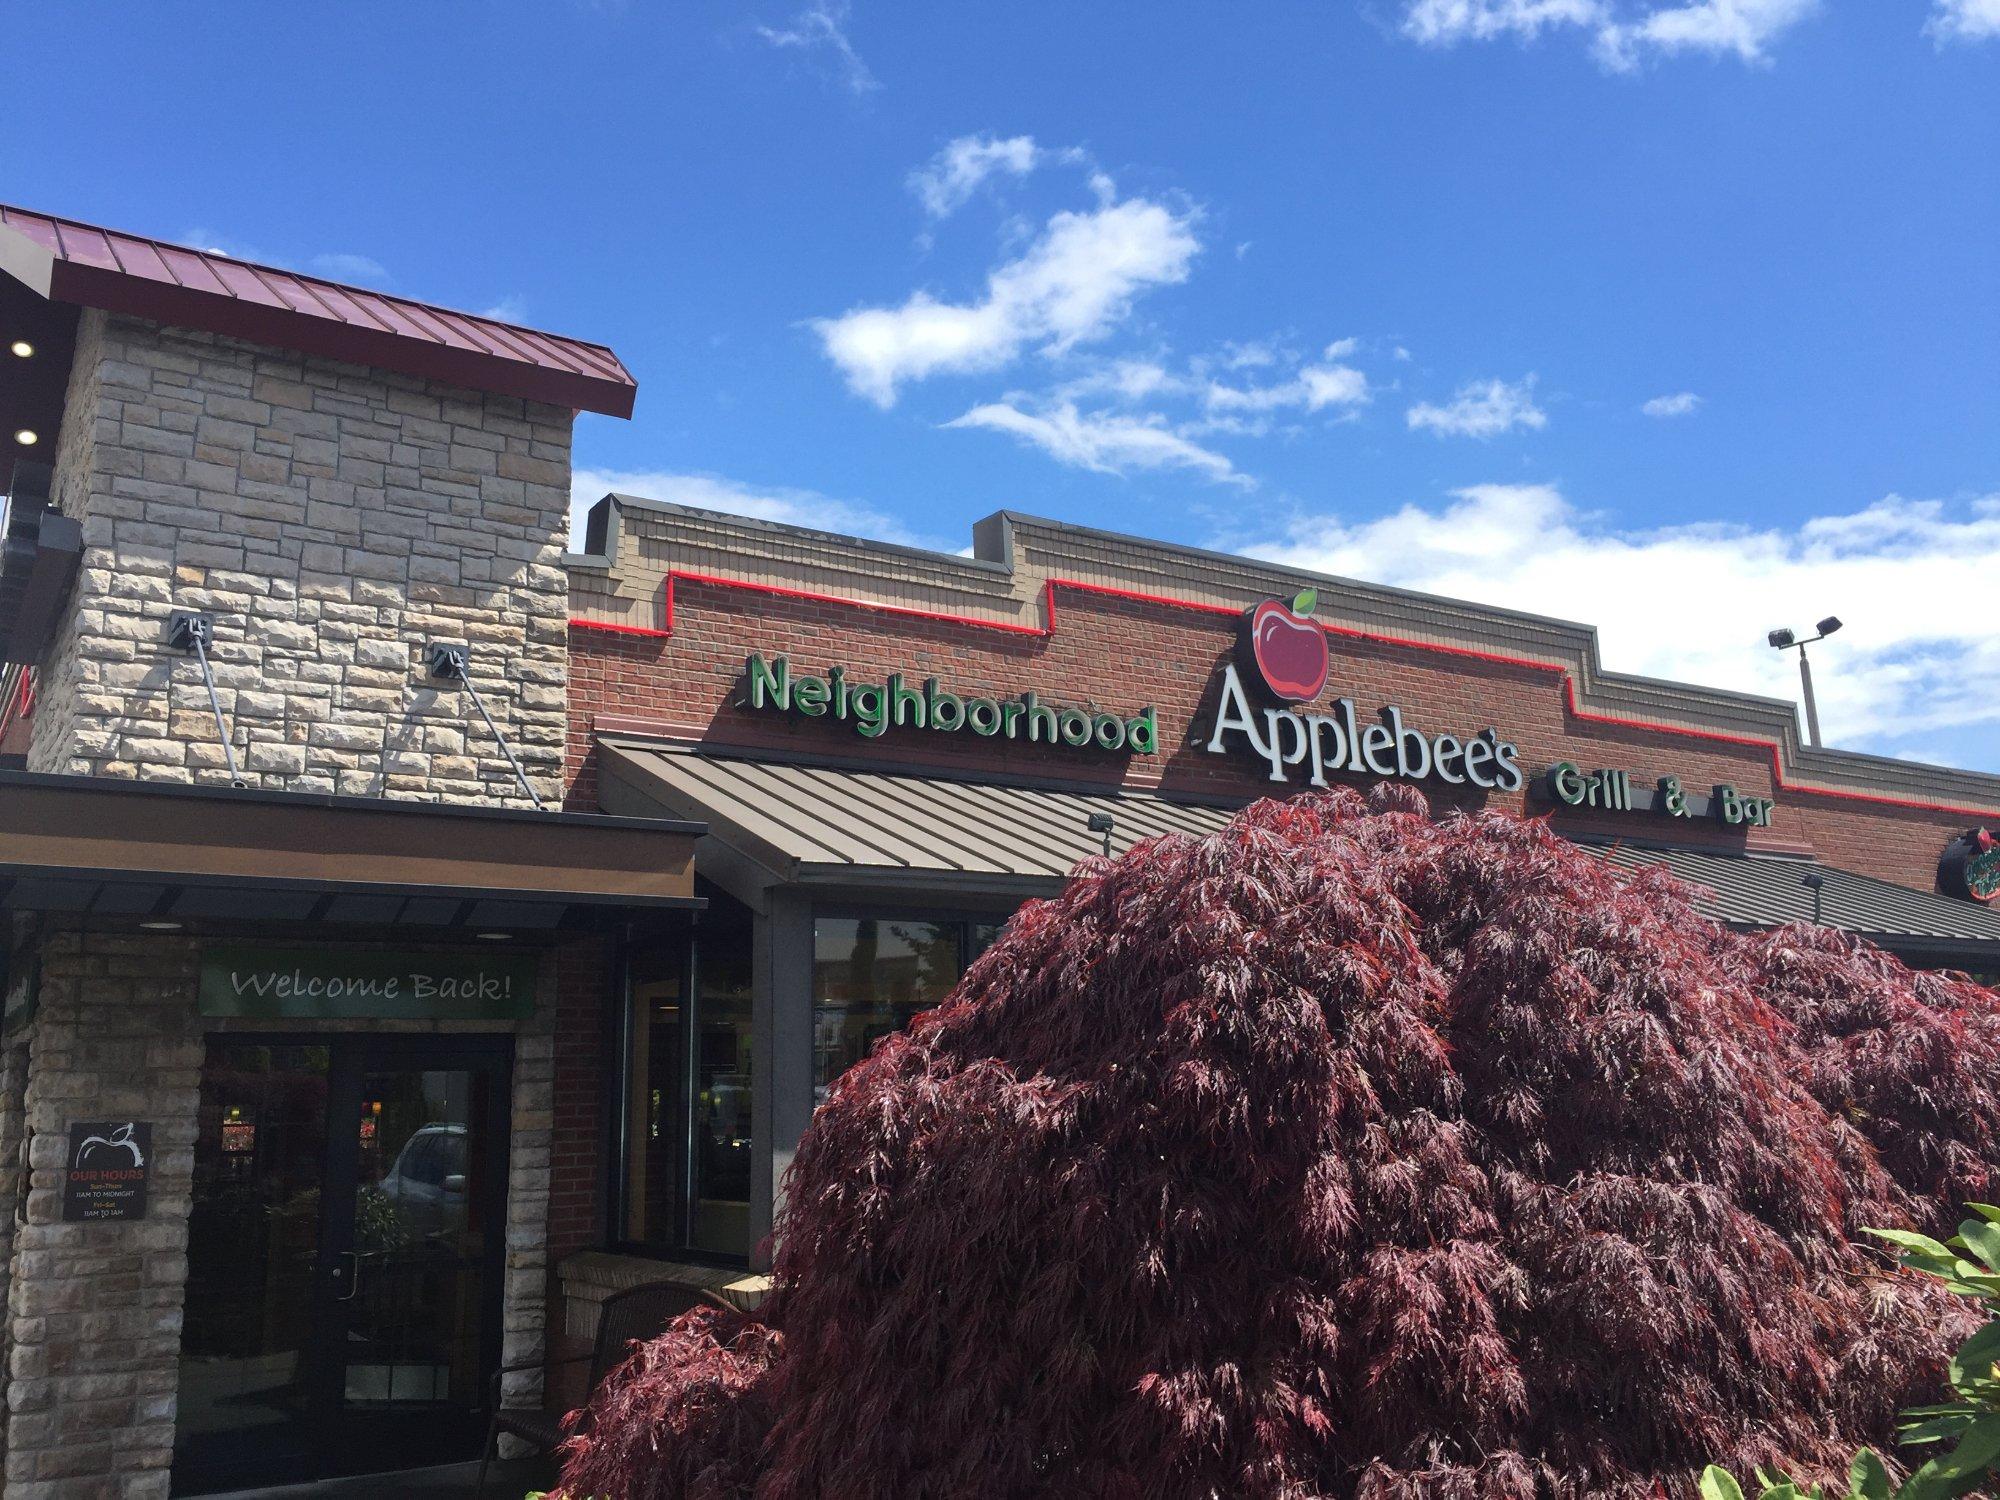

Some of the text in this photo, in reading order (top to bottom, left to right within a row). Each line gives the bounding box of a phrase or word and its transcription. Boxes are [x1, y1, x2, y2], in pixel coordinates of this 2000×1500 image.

[746, 652, 1158, 754] Neighborhood
[1207, 663, 1523, 791] Applebee's
[1549, 761, 1776, 827] Grill & Bar
[231, 969, 511, 999] Welcome Back!
[70, 1169, 144, 1181] OUR HOURS
